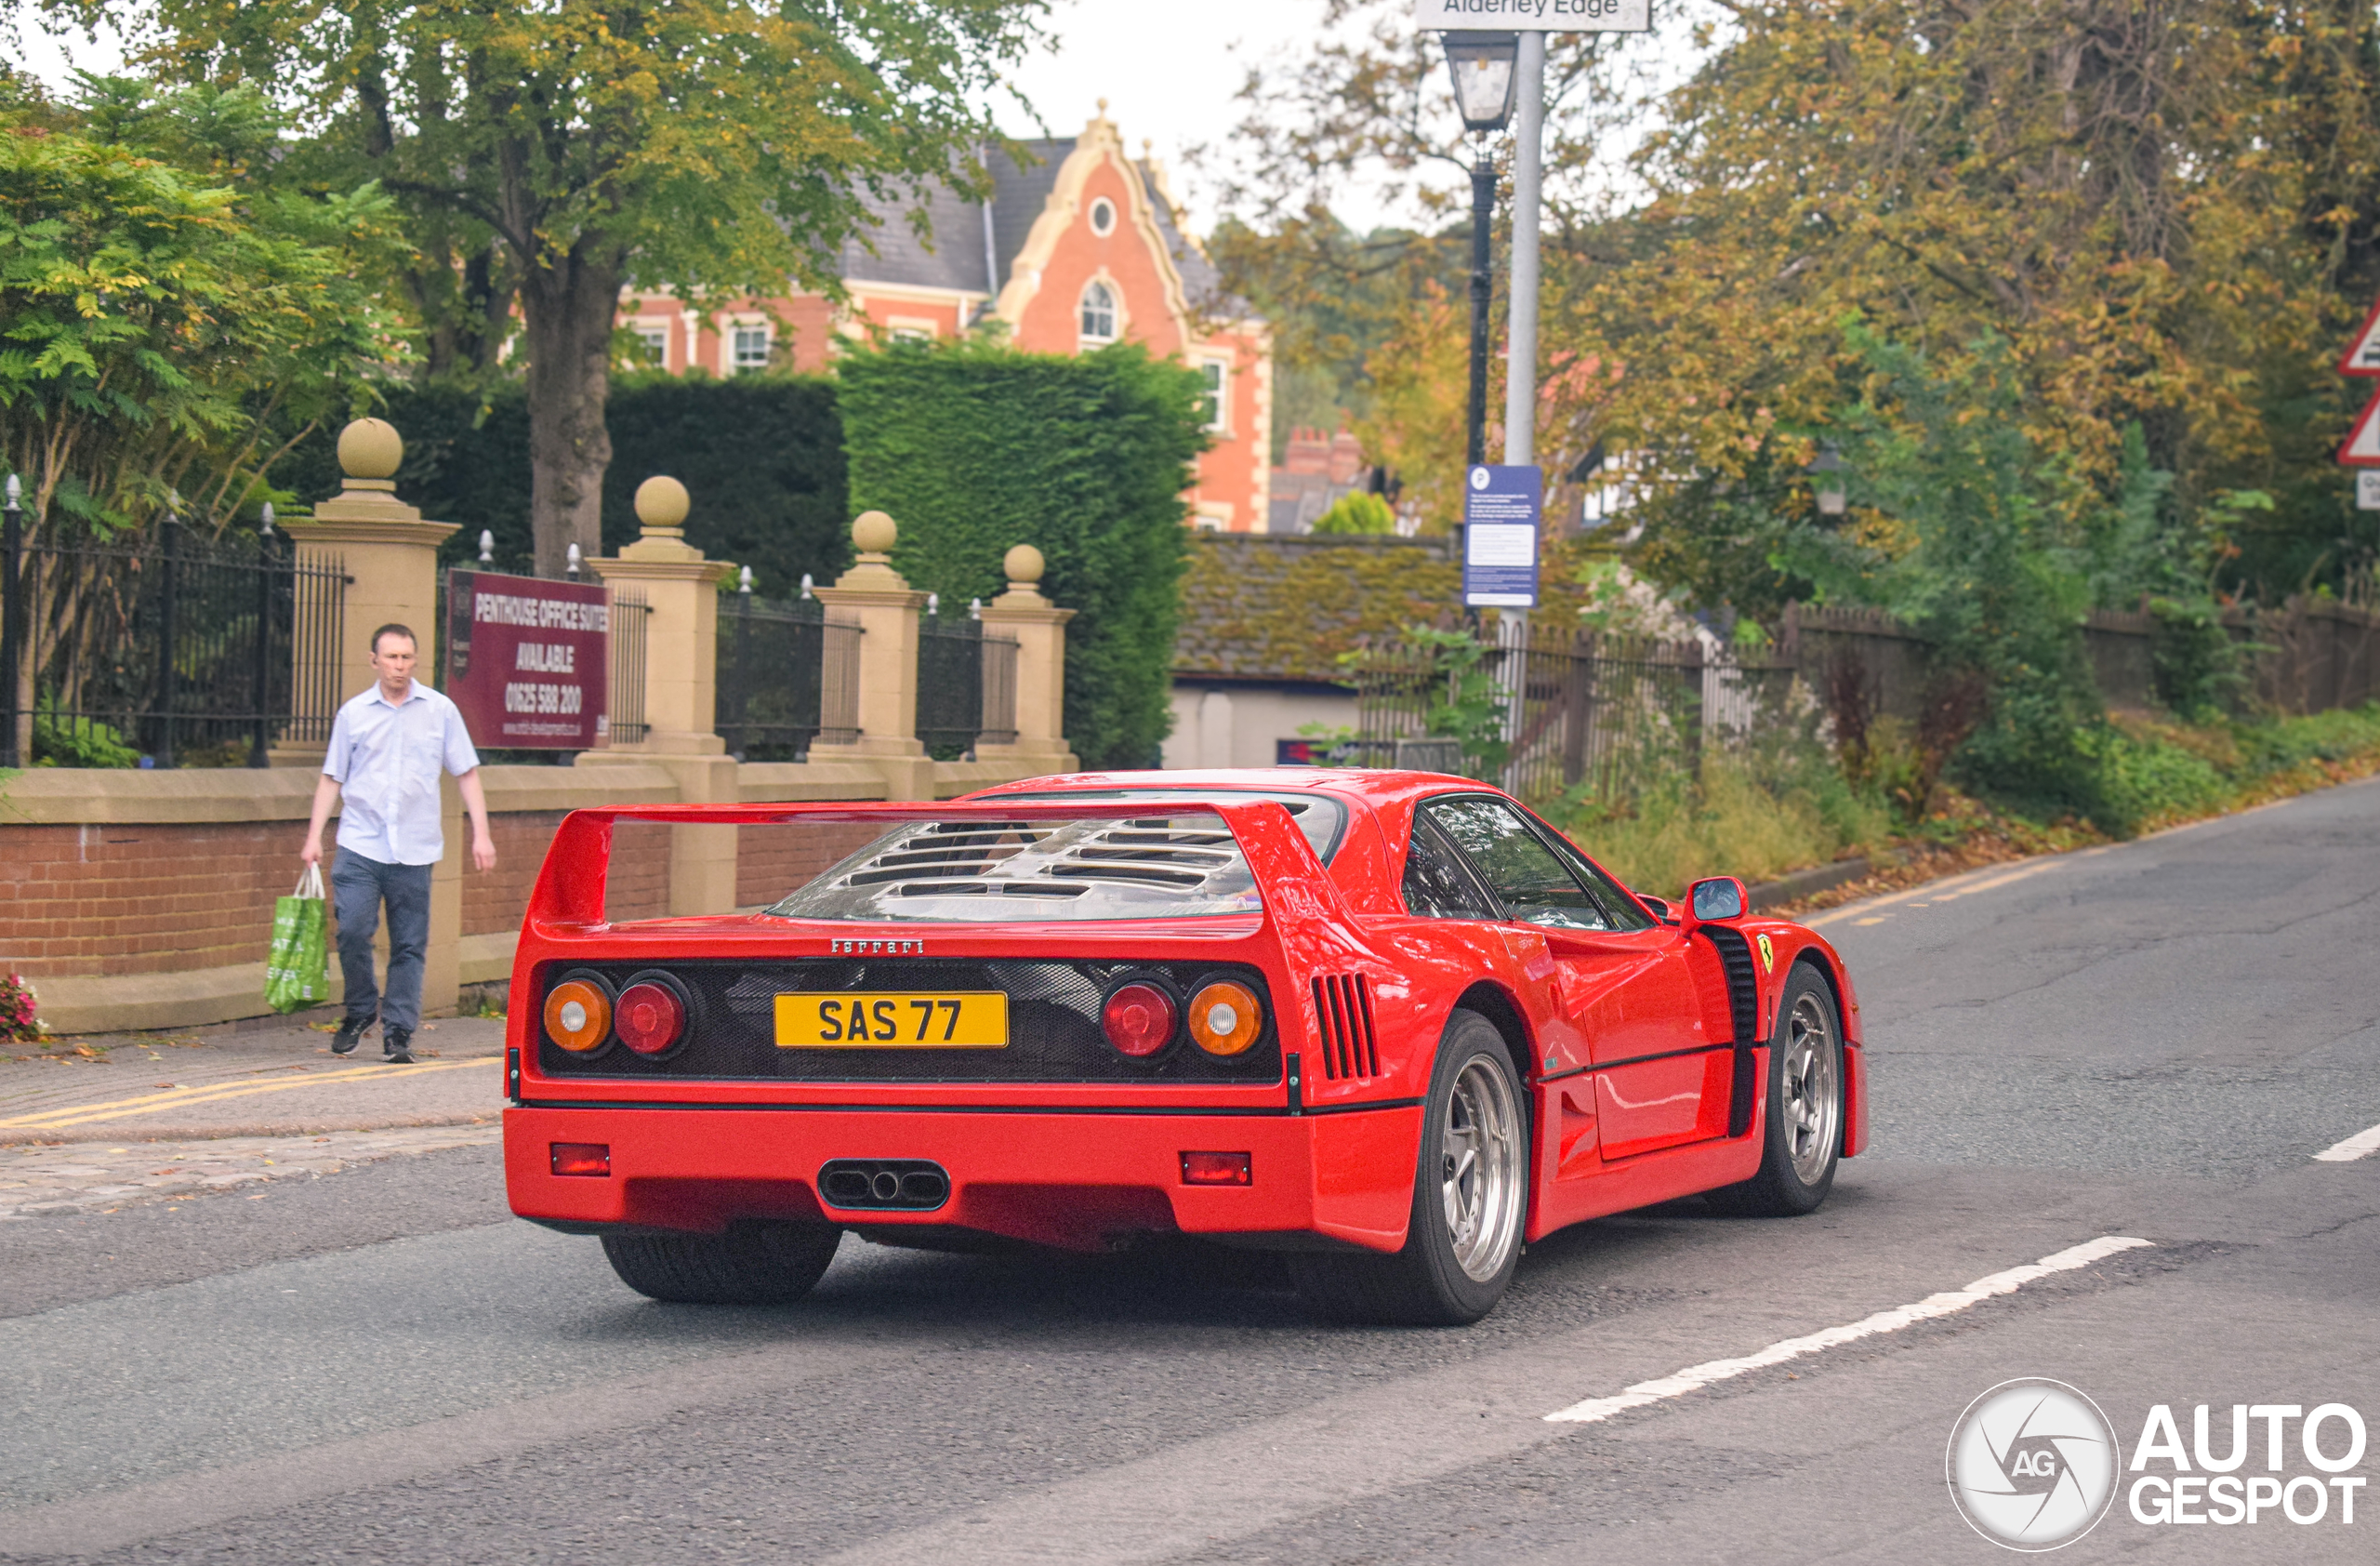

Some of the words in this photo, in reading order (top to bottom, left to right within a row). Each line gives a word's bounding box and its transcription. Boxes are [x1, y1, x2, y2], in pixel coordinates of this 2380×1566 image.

[1443, 0, 1547, 18] Alderley
[1554, 0, 1619, 19] Edge
[475, 592, 538, 626] PENTHOUSE
[538, 599, 578, 630] OFFICE
[579, 604, 609, 632] SUITES
[515, 642, 575, 673] AVAILABLE
[505, 682, 536, 713] 01625
[560, 685, 582, 714] 200
[831, 938, 924, 954] Ferrari
[819, 1000, 897, 1041] SAS
[910, 1000, 962, 1041] 77
